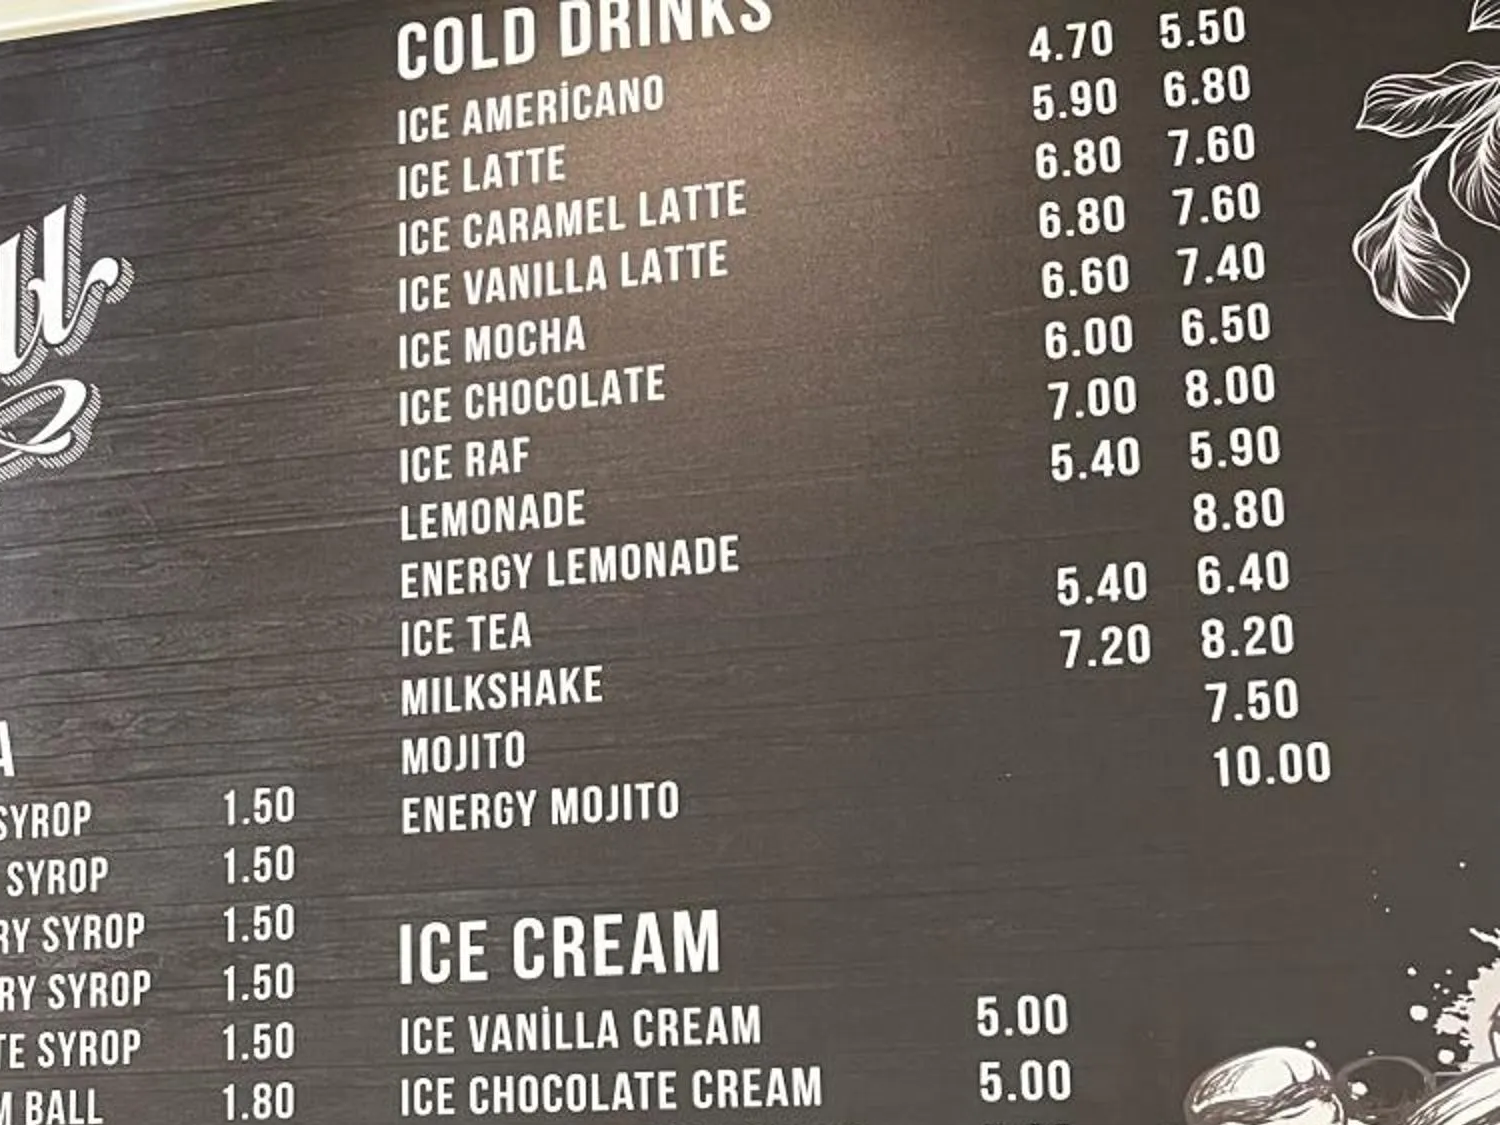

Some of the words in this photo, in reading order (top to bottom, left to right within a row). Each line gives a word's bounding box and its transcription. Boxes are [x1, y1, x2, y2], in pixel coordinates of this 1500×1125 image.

[397, 7, 535, 81] COLD
[560, 0, 772, 57] DRINKS
[1028, 19, 1113, 63] 4.70
[1159, 5, 1246, 49] 5.50
[1033, 77, 1117, 121] 5.90
[1163, 64, 1251, 108] 6.80
[398, 103, 450, 145] ICE
[398, 159, 450, 201] ICE
[463, 144, 565, 193] LATTE
[1035, 135, 1122, 180] 6.80
[1167, 122, 1255, 167] 7.60
[398, 216, 450, 257] ICE
[463, 195, 626, 249] CARAMEL
[639, 179, 747, 227] LATTE
[1039, 194, 1126, 239] 6.80
[1171, 181, 1261, 226] 7.60
[399, 273, 451, 314] ICE
[463, 255, 607, 305] VANILLA
[621, 239, 728, 287] LATTE
[1041, 254, 1130, 299] 6.60
[1176, 241, 1265, 286] 7.40
[399, 329, 451, 370] ICE
[465, 315, 586, 363] MOCHA
[1045, 314, 1133, 360] 6.00
[1181, 302, 1271, 347] 6.50
[399, 386, 452, 427] ICE
[465, 363, 665, 420] CHOCOLATE
[1047, 375, 1137, 421] 7.00
[1185, 363, 1275, 409] 8.00
[400, 443, 453, 484] ICE
[465, 436, 530, 478] RAF
[1051, 436, 1141, 482] 5.40
[1190, 425, 1281, 470] 5.90
[400, 488, 586, 542] LEMONADE
[1193, 487, 1285, 533] 8.80
[401, 552, 533, 599] ENERGY
[547, 534, 739, 587] LEMONADE
[1057, 561, 1147, 607] 5.40
[1197, 550, 1290, 596] 6.40
[401, 617, 455, 658] ICE
[465, 611, 532, 652] TEA
[1059, 623, 1151, 669] 7.20
[1201, 613, 1295, 659] 8.20
[401, 665, 603, 717] MILKSHAKE
[1204, 677, 1299, 723] 7.50
[401, 730, 525, 775] MOJITO
[1213, 741, 1331, 787] 10.00
[223, 785, 295, 826] 1.50
[402, 789, 537, 835] ENERGY
[551, 780, 679, 825] MOJITO
[6, 856, 109, 897] SYROP
[223, 844, 295, 884] 1.50
[42, 911, 145, 953] SYROP
[223, 903, 295, 943] 1.50
[399, 919, 488, 985] ICE
[513, 909, 719, 980] CREAM
[47, 969, 151, 1010] SYROP
[223, 962, 295, 1002] 1.50
[222, 1021, 295, 1061] 1.50
[401, 1015, 455, 1056] ICE
[633, 1004, 761, 1048] CREAM
[976, 993, 1069, 1037] 5.00
[37, 1028, 141, 1069] SYROP
[222, 1081, 295, 1121] 1.80
[401, 1077, 455, 1117] ICE
[469, 1070, 677, 1115] CHOCOLATE
[692, 1066, 822, 1109] CREAM
[979, 1059, 1071, 1103] 5.00
